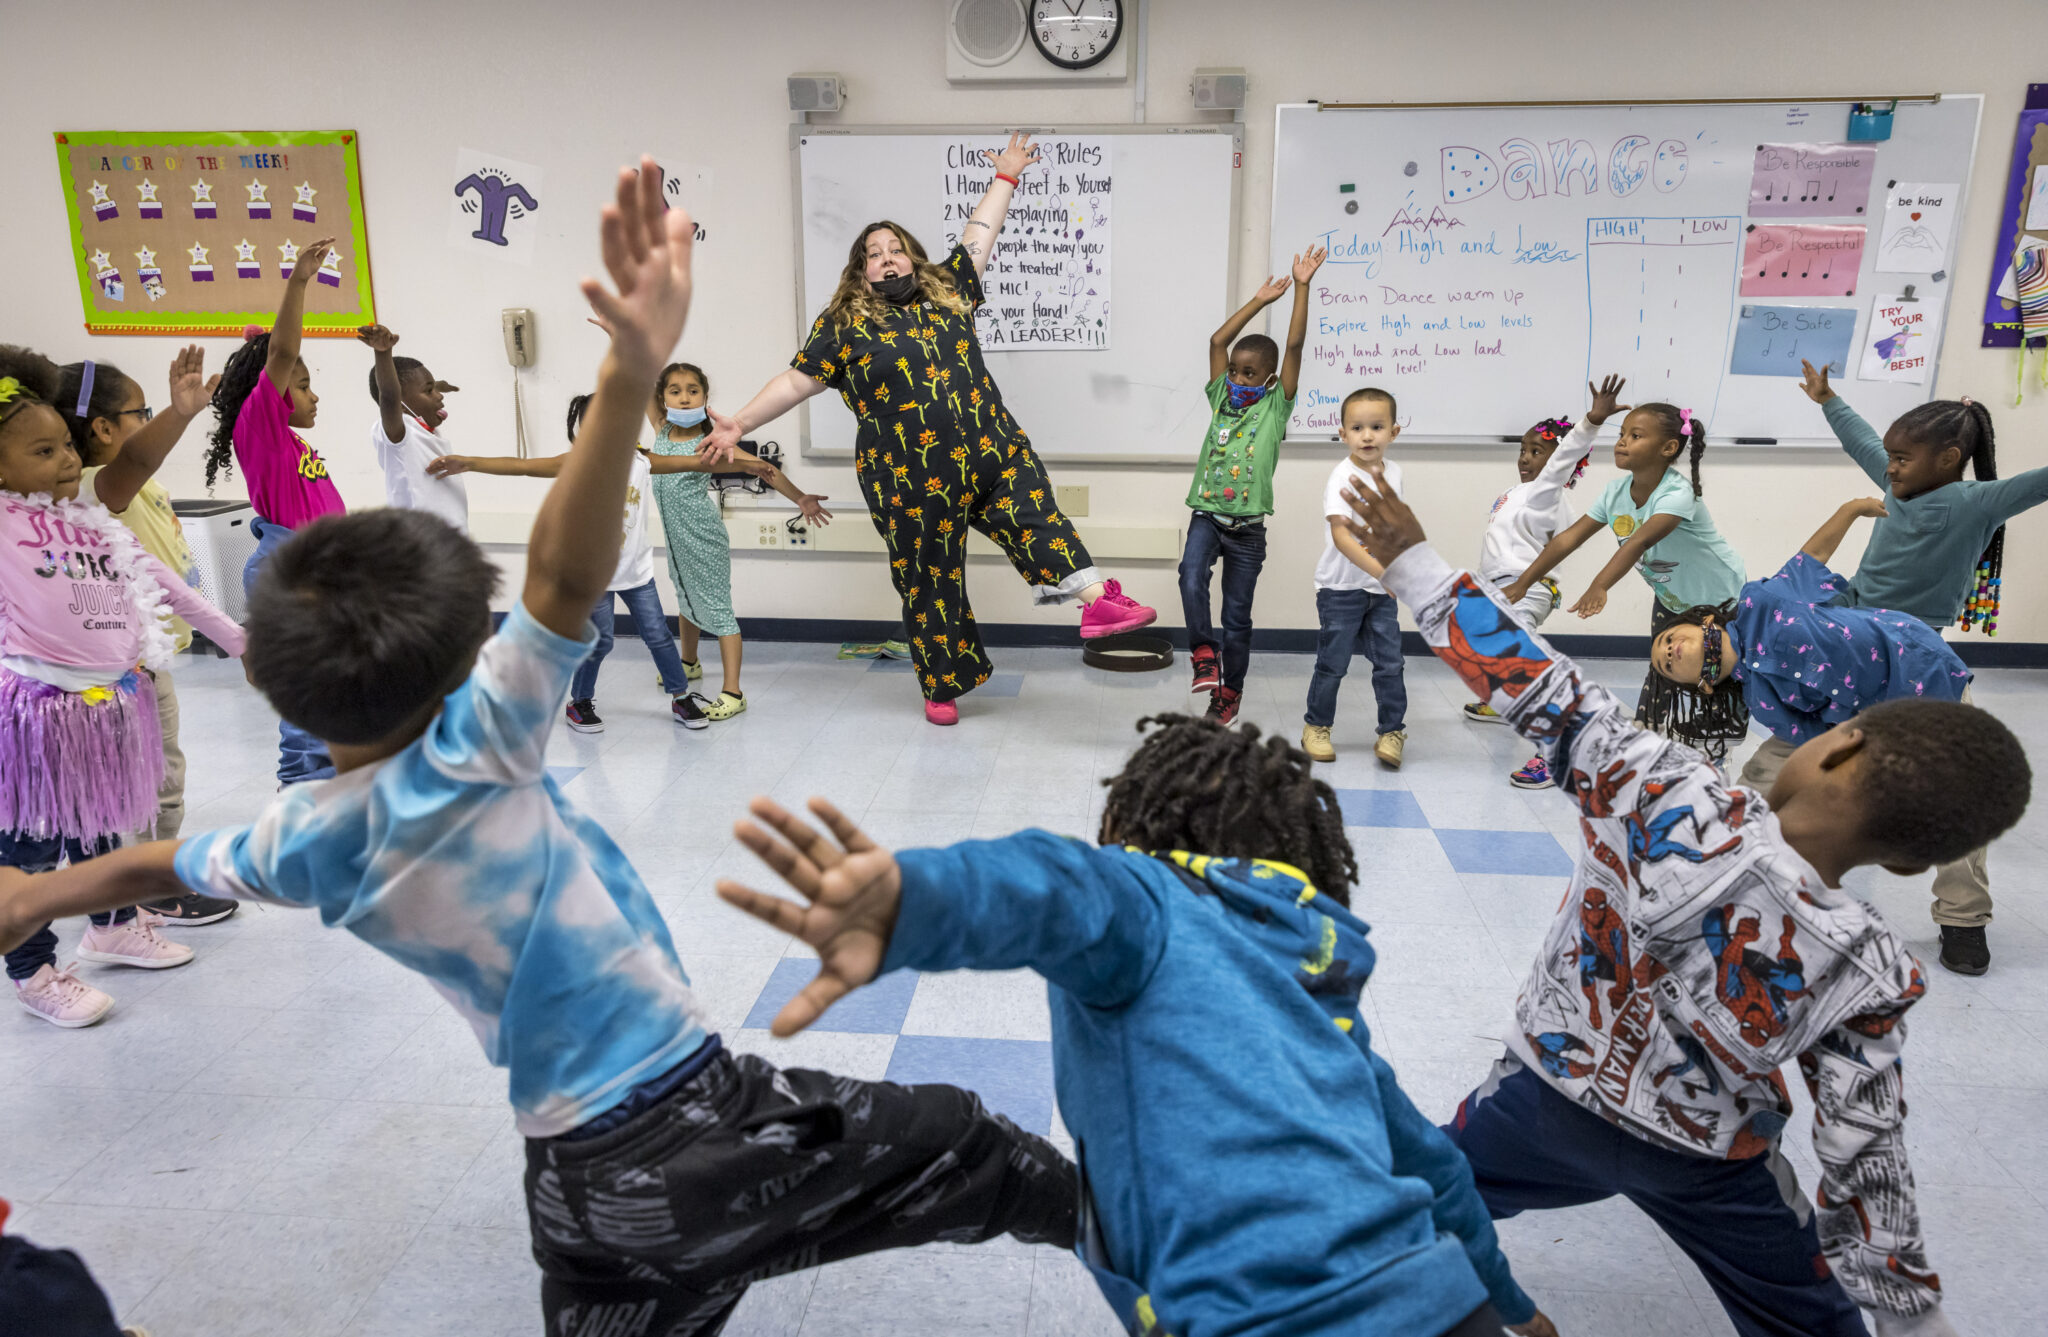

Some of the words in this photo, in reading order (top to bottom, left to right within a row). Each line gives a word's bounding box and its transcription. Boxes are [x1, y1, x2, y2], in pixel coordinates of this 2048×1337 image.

[1042, 31, 1049, 42] 8
[1101, 29, 1108, 39] 4
[1056, 46, 1061, 55] 7
[1071, 49, 1079, 60] 6
[1089, 45, 1096, 54] 5
[947, 143, 1041, 168] Classr
[1056, 141, 1102, 166] Rules
[1761, 149, 1790, 171] Be
[1795, 149, 1861, 173] Responsible
[1022, 172, 1050, 196] Feet
[1056, 175, 1070, 195] to
[1897, 195, 1913, 208] be
[1918, 195, 1943, 207] kind
[1006, 203, 1068, 231] seplaying
[1595, 221, 1639, 237] HIGH
[1692, 219, 1728, 234] LOW
[996, 239, 1029, 258] people
[1031, 240, 1049, 254] the
[1053, 243, 1076, 258] way
[1081, 243, 1104, 260] you
[1400, 229, 1445, 264] High
[1461, 230, 1503, 256] and
[1516, 224, 1558, 255] Low
[1758, 231, 1784, 254] Be
[1790, 230, 1861, 255] Respectful
[999, 261, 1014, 273] be
[1019, 261, 1063, 276] treated!
[1000, 280, 1029, 296] MIC!
[1317, 287, 1368, 306] Brain
[1378, 285, 1436, 306] Dance
[1448, 289, 1495, 302] warm
[1001, 307, 1026, 321] your
[1032, 303, 1068, 319] Hand!
[1762, 311, 1788, 331] Be
[1795, 312, 1832, 331] Safe
[1880, 306, 1904, 319] TRY
[1889, 313, 1924, 327] YOUR
[1319, 316, 1369, 337] Explore
[1381, 314, 1411, 337] High
[1423, 317, 1451, 330] and
[1459, 316, 1486, 330] Low
[1501, 313, 1533, 329] levels
[993, 328, 1005, 344] A
[1314, 345, 1344, 367] High
[1353, 343, 1383, 357] land
[1435, 343, 1460, 357] Low
[1474, 339, 1506, 357] land
[1359, 364, 1383, 377] new
[1890, 356, 1925, 371] BEST!
[1306, 388, 1340, 408] Show
[1307, 412, 1341, 429] Goodb
[34, 550, 120, 582] JUIC
